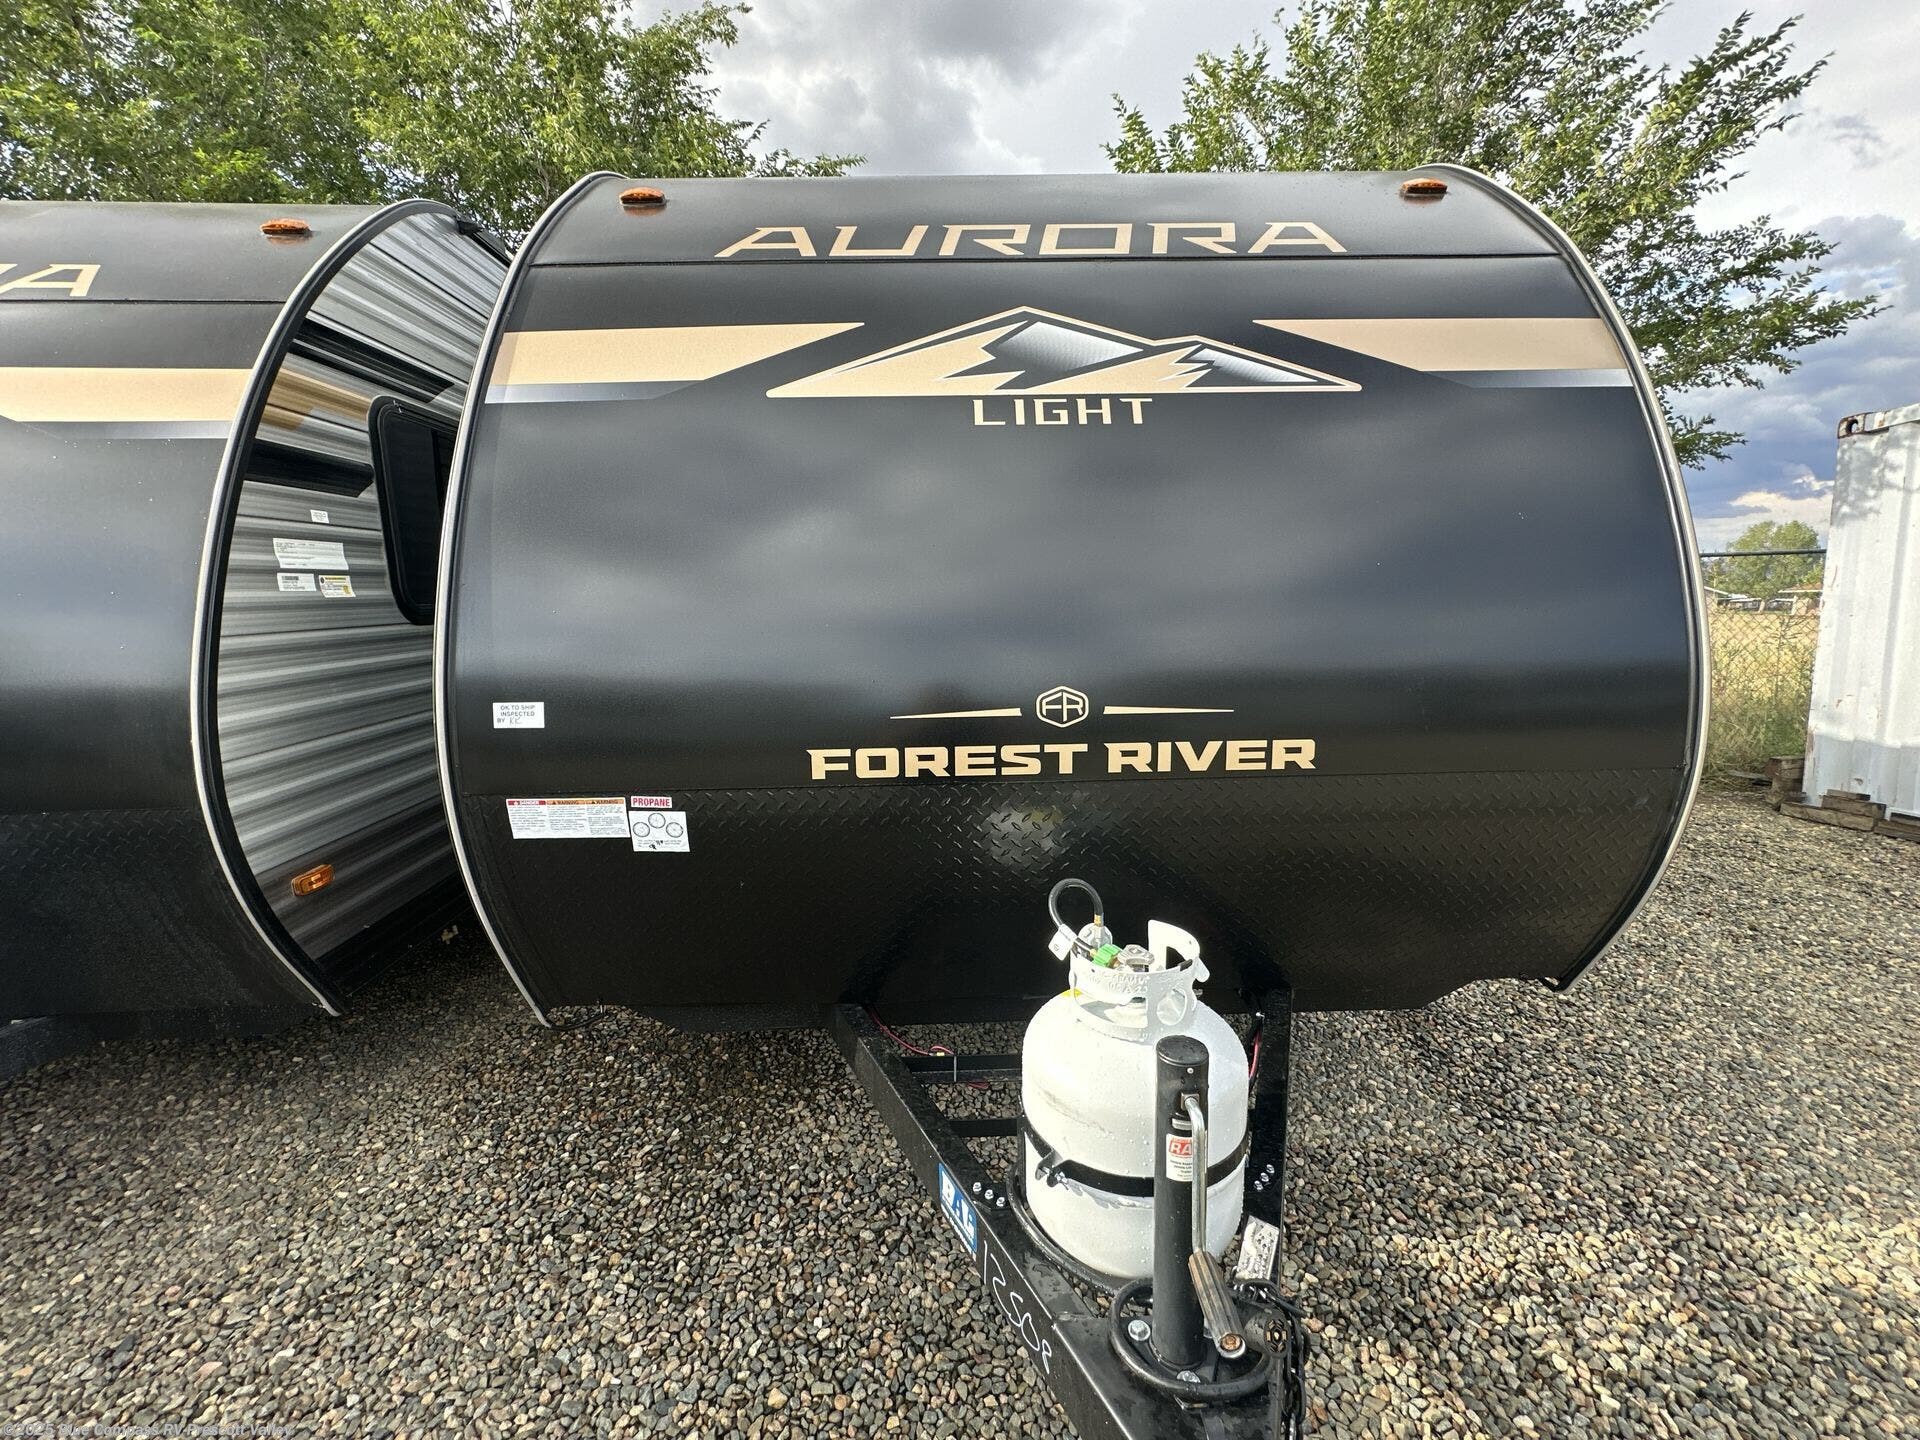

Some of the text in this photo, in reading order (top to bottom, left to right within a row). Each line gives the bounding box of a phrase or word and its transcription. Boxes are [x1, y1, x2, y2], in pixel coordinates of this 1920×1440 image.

[714, 222, 1348, 257] AURORA
[972, 398, 1153, 427] LIGHT
[806, 738, 1317, 780] FOREST RIVER
[632, 797, 671, 808] PROPANE
